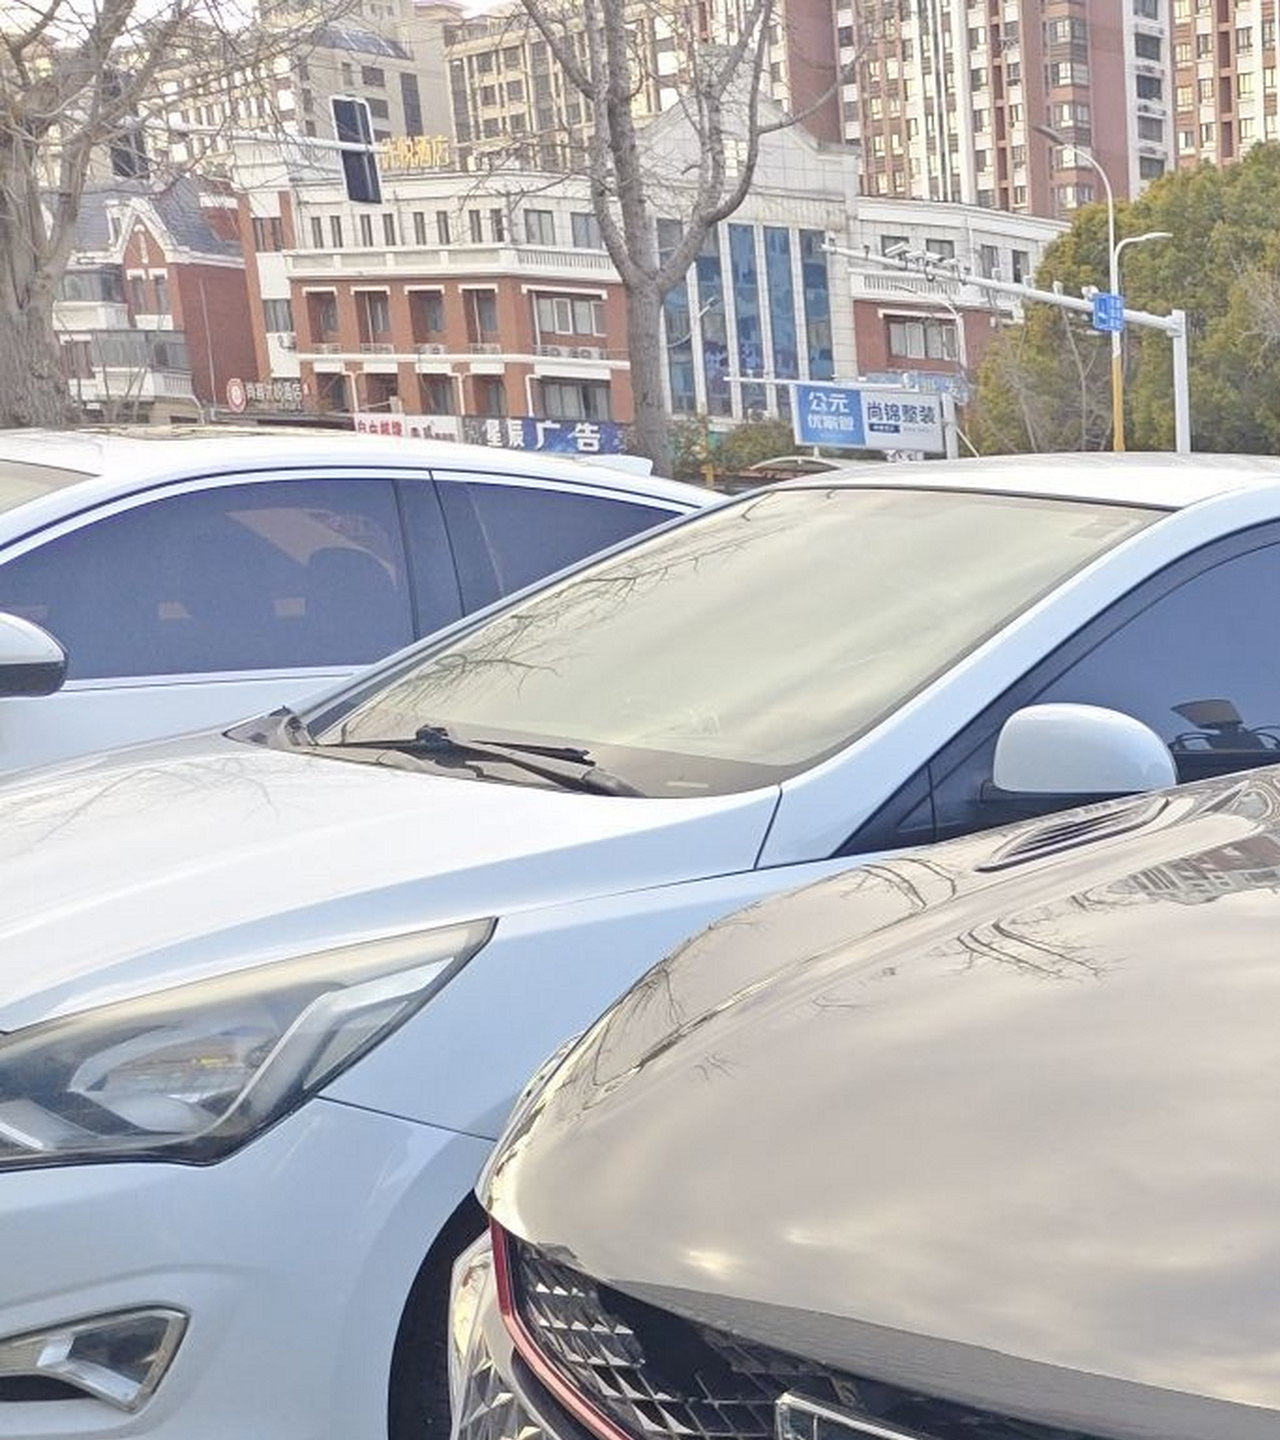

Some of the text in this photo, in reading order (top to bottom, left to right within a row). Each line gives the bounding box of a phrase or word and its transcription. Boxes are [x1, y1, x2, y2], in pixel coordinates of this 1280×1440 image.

[808, 391, 850, 413] 公元
[867, 402, 937, 425] 尚锦整装
